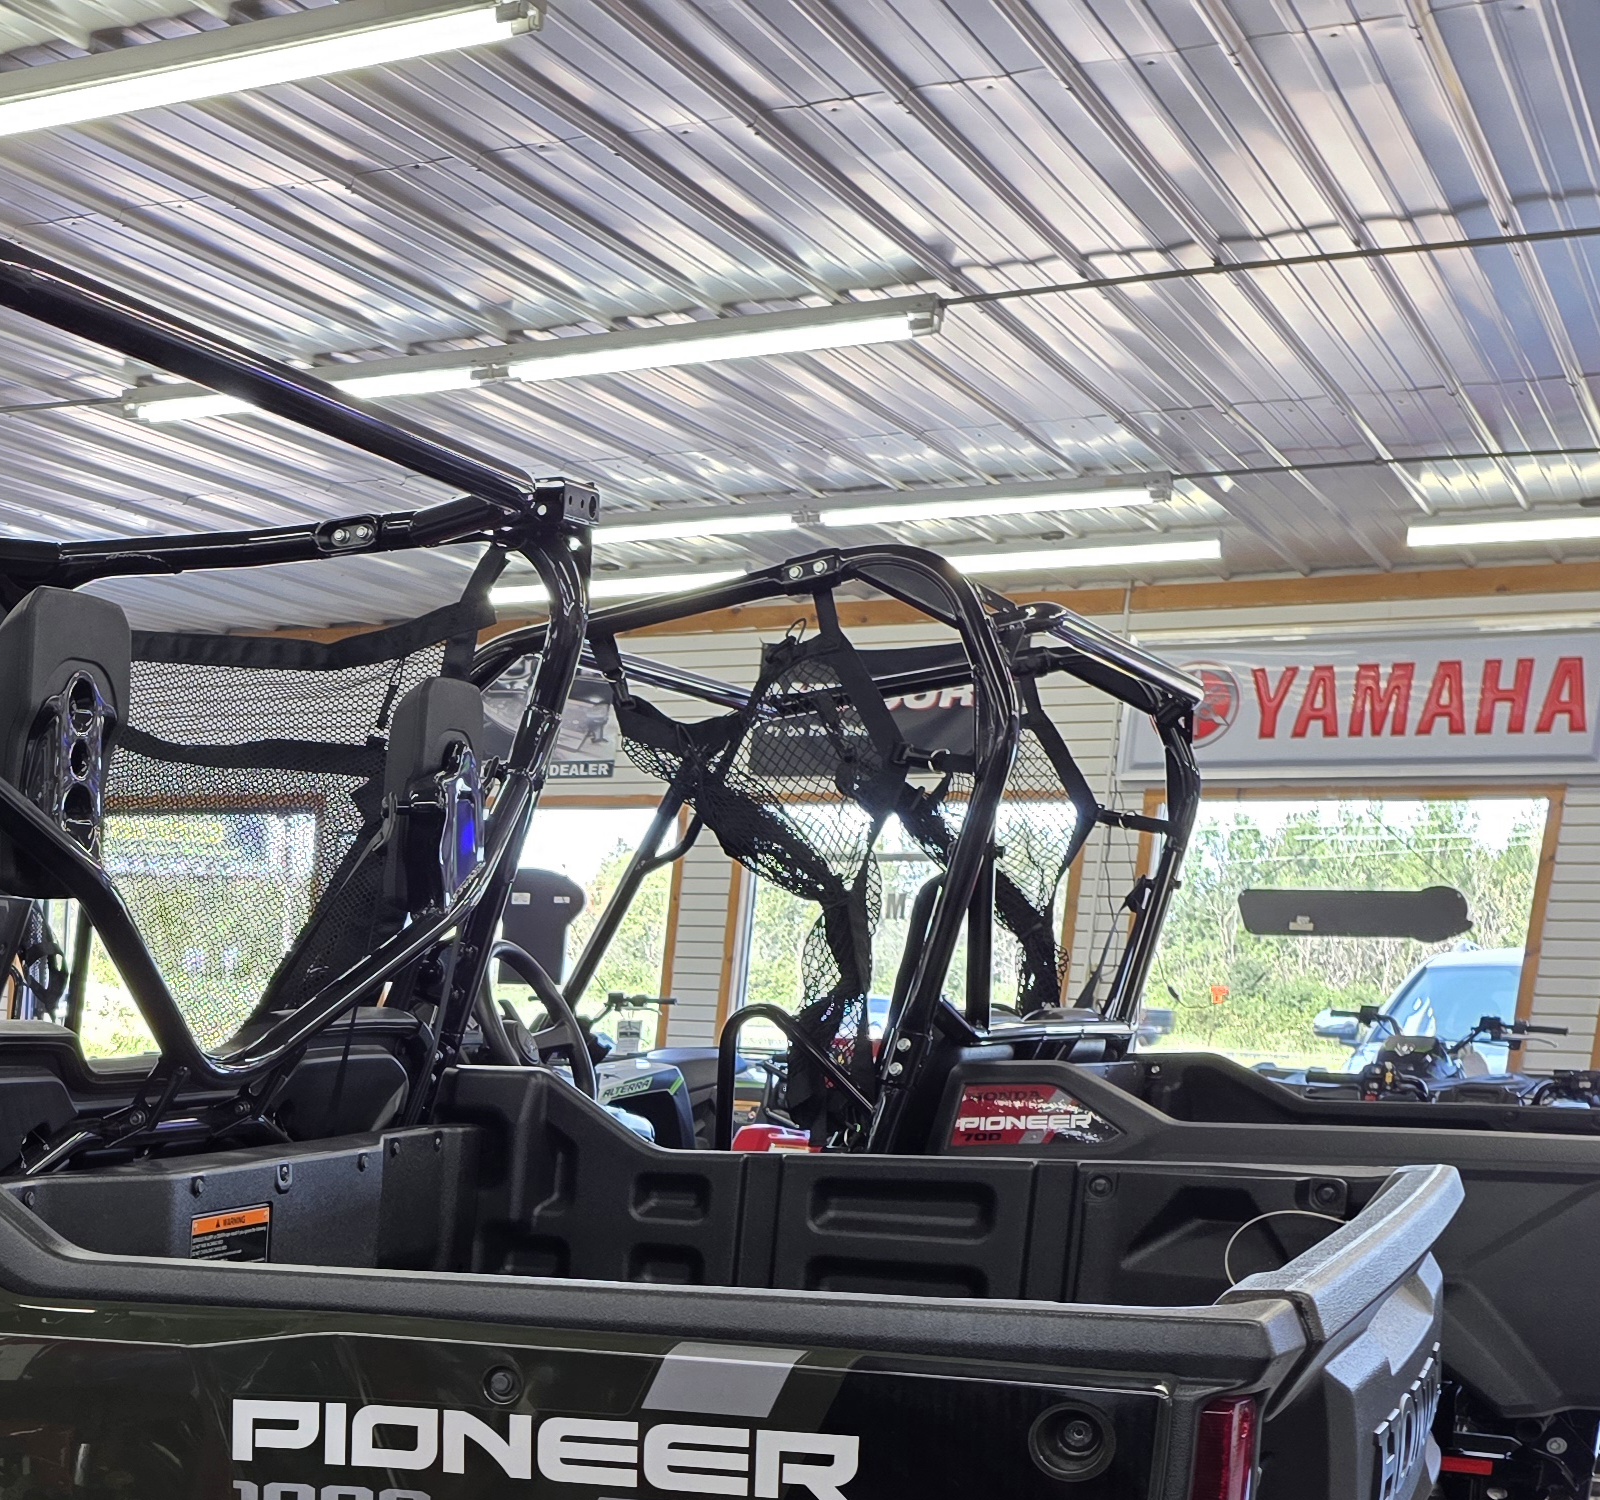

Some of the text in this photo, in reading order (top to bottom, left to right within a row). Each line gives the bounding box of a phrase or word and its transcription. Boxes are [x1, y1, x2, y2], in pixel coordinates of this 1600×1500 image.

[1251, 655, 1587, 740] YAMAHA
[549, 763, 609, 776] DEALER
[602, 1079, 650, 1098] ALTERRA
[966, 1089, 1042, 1102] HONDA
[959, 1114, 1092, 1132] PIONEER
[963, 1132, 1003, 1142] 700
